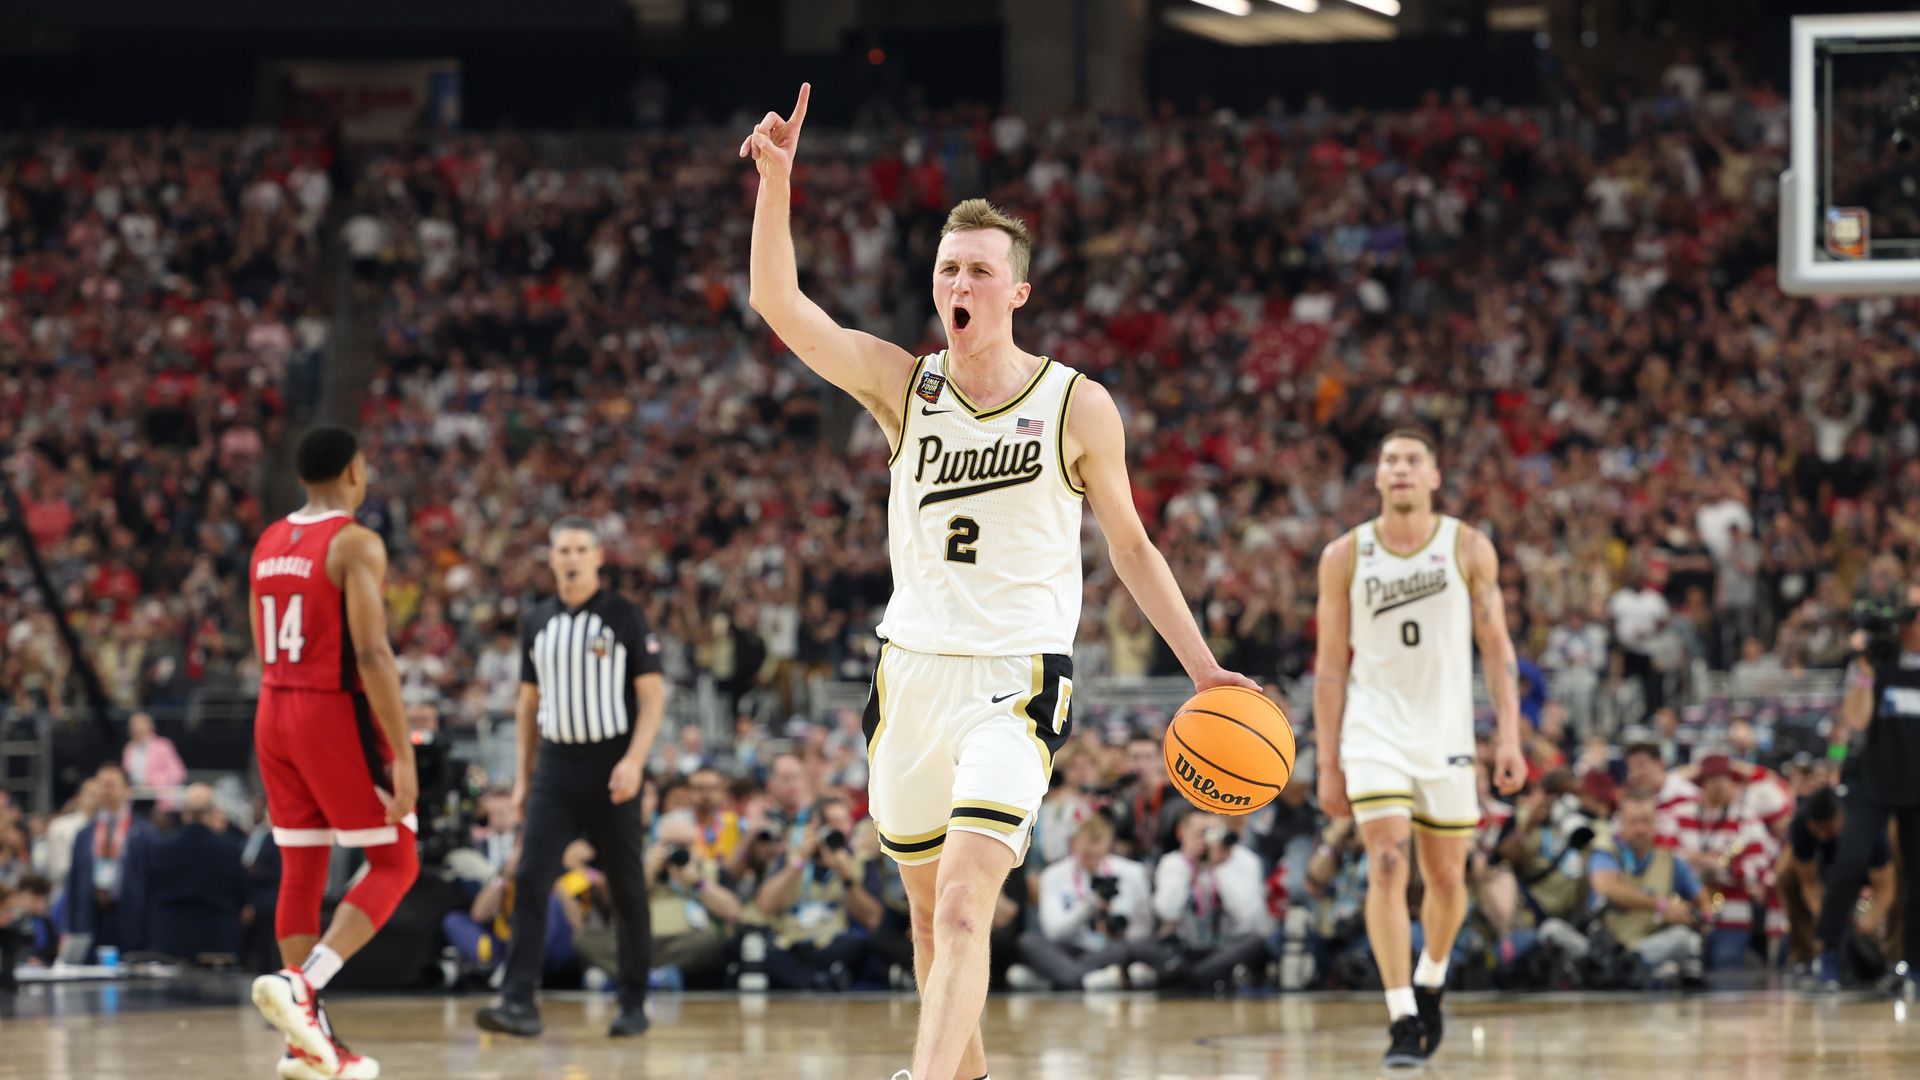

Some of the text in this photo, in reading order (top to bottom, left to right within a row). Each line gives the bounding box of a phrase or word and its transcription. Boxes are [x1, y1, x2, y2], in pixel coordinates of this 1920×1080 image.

[921, 383, 938, 393] FOUR
[923, 377, 941, 387] FINAL
[914, 434, 1043, 488] Purdue
[944, 514, 980, 565] 2
[1364, 567, 1447, 608] Purdue
[260, 593, 306, 664] 14
[1401, 619, 1421, 647] 0
[1174, 752, 1252, 806] Wilson
